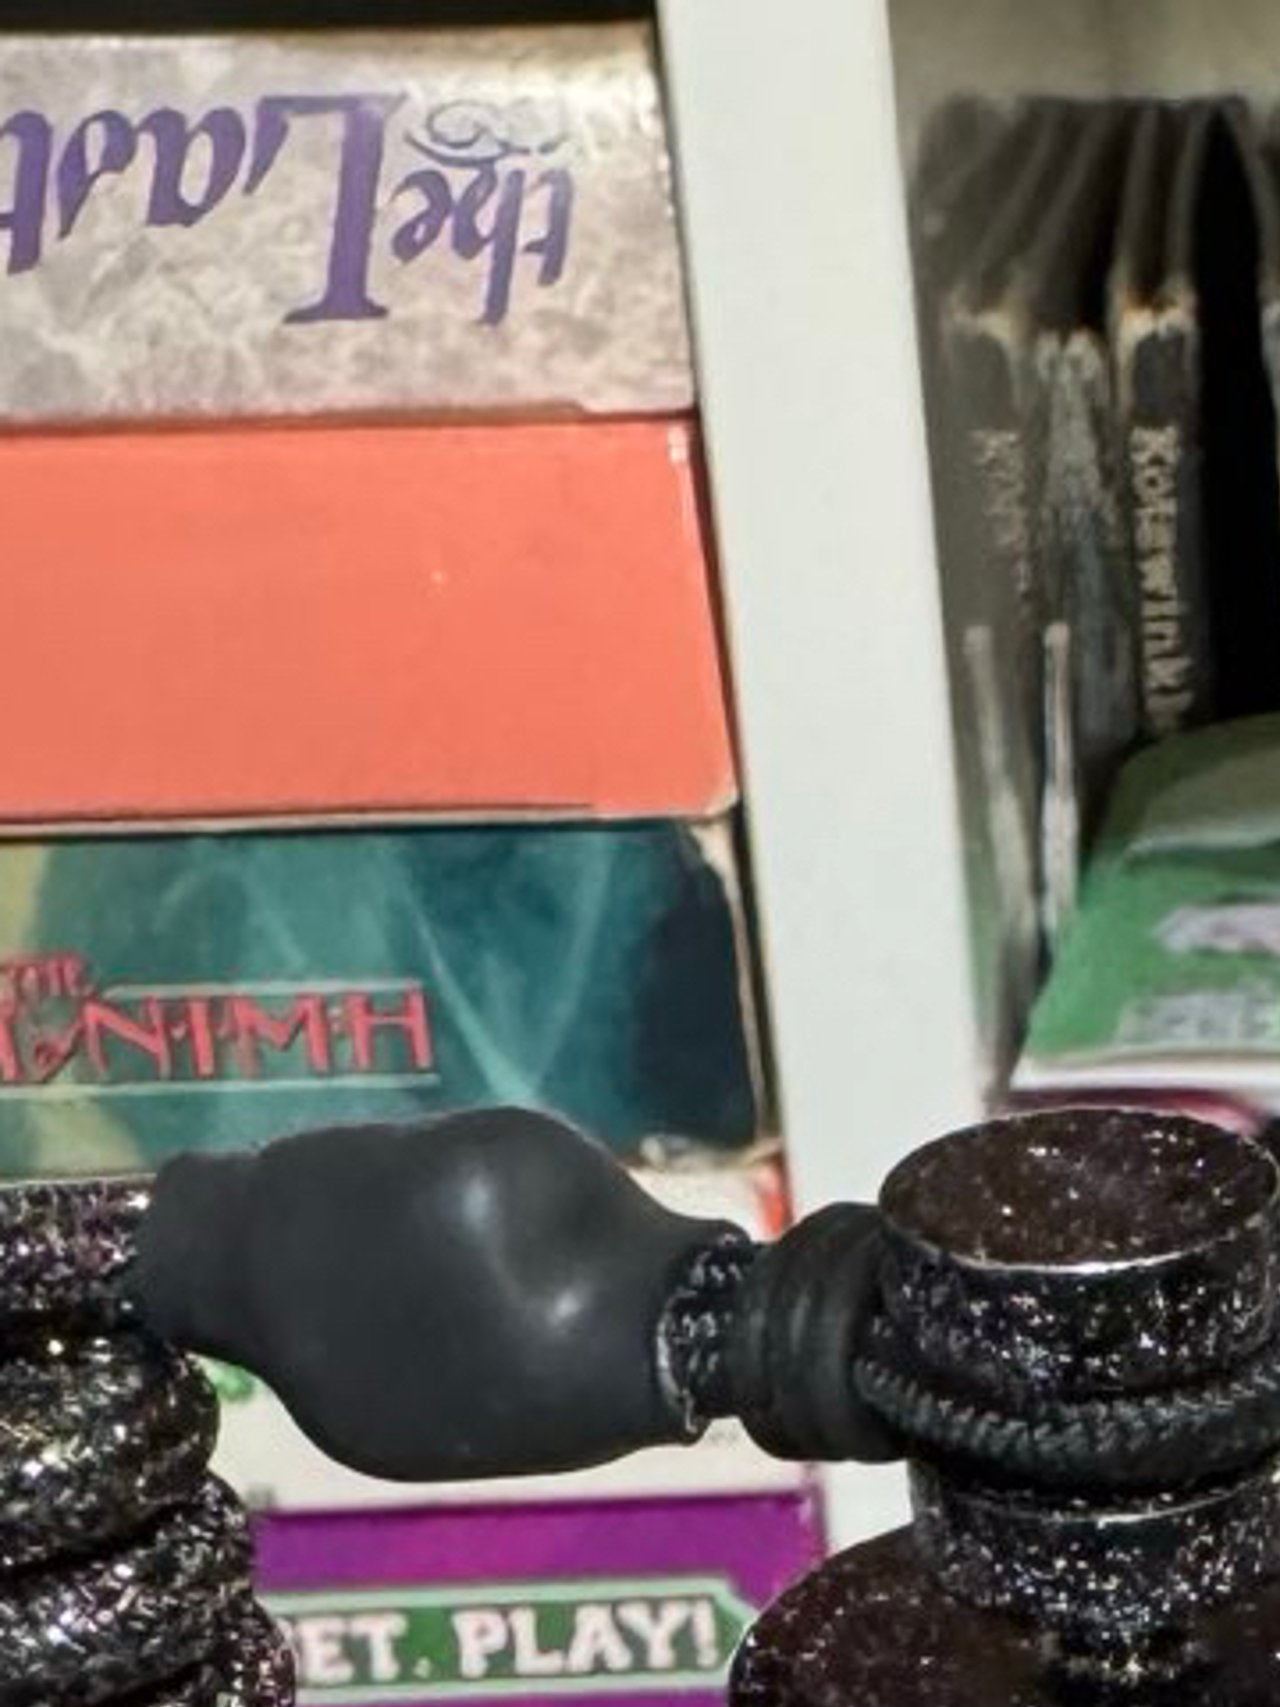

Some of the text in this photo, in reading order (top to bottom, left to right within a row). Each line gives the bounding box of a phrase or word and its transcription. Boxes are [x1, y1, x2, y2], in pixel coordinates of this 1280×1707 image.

[0, 94, 577, 327] the Last
[276, 1596, 719, 1684] ET. PLAY!
